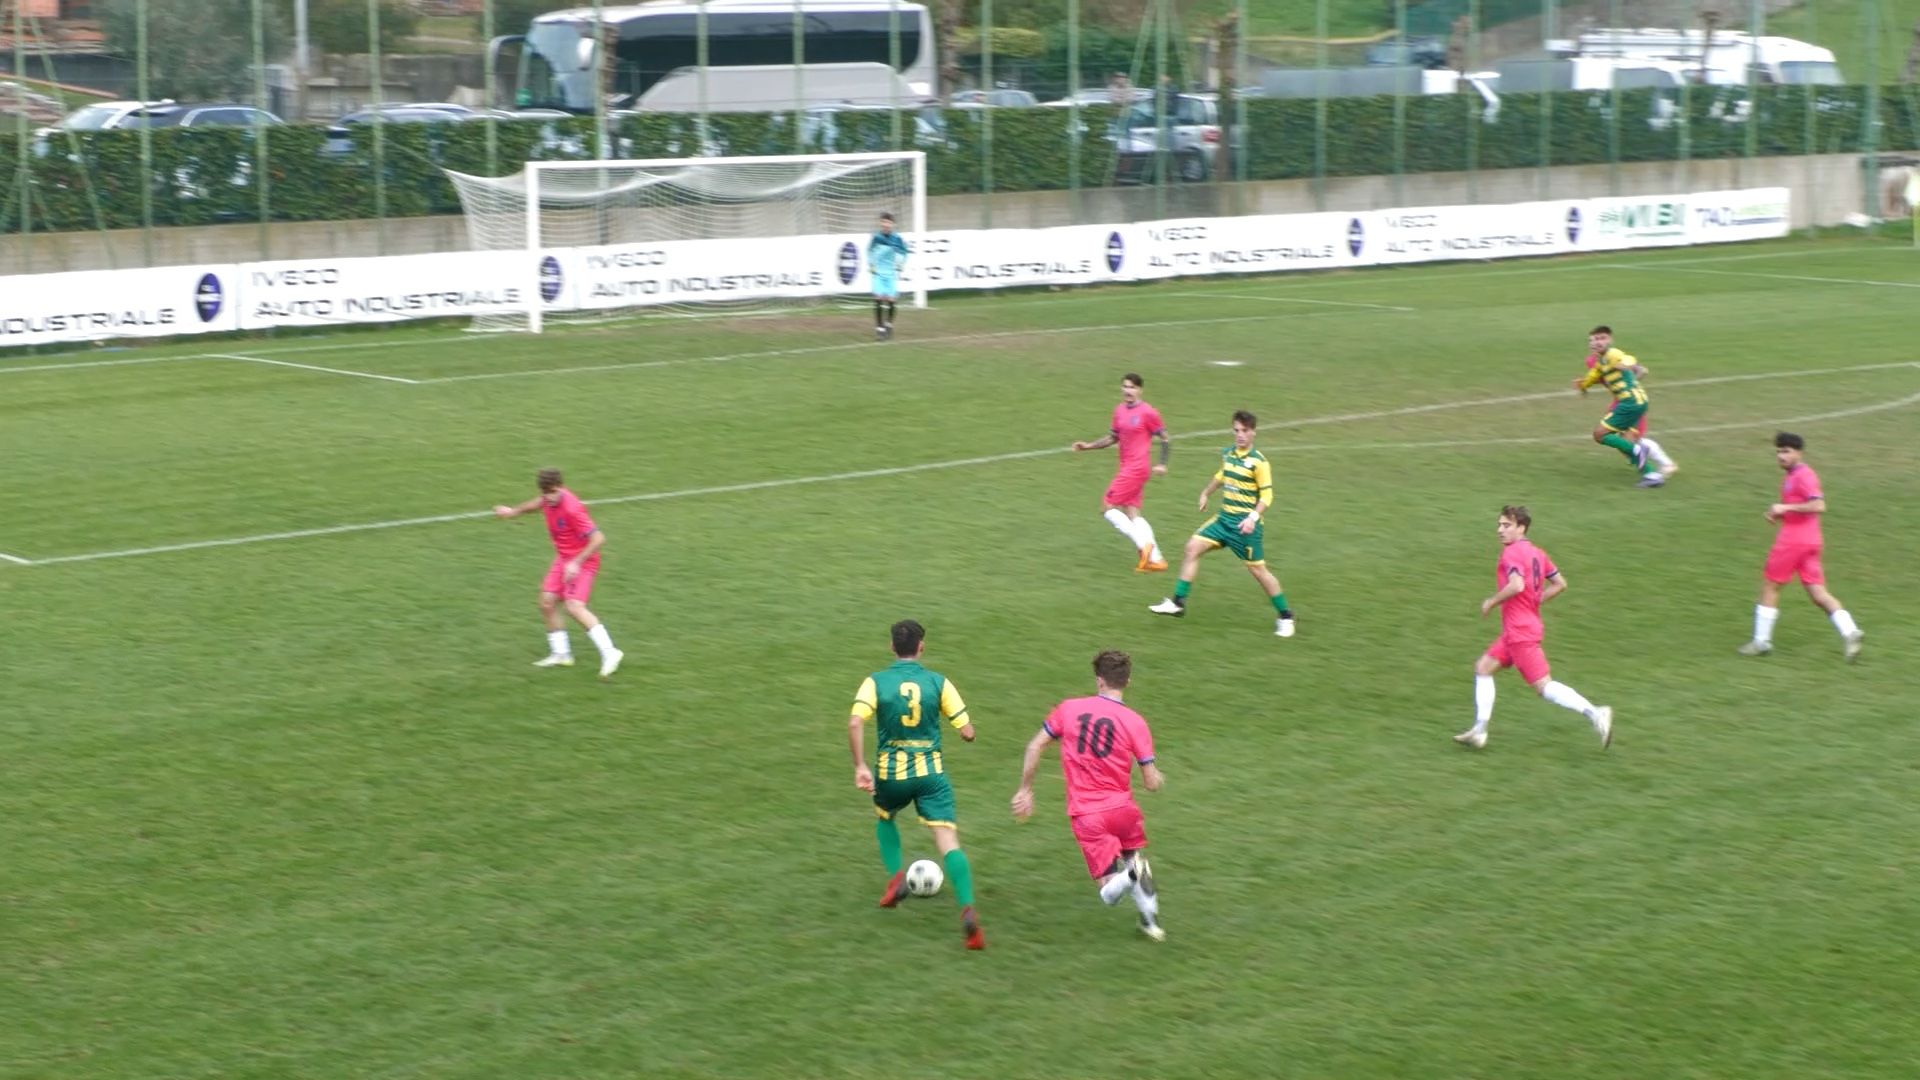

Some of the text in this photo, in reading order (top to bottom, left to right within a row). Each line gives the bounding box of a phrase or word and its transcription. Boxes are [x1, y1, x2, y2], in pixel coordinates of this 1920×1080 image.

[587, 250, 667, 269] IVECO
[954, 260, 1092, 279] INDUSTRIALE
[252, 268, 340, 287] IVECO
[590, 271, 823, 298] AUTO INDUSTRIALE
[254, 288, 521, 317] AUTO INDUSTRIALE
[0, 308, 175, 334] DUSTRIALE
[899, 682, 922, 729] 3
[1076, 713, 1115, 759] 10
